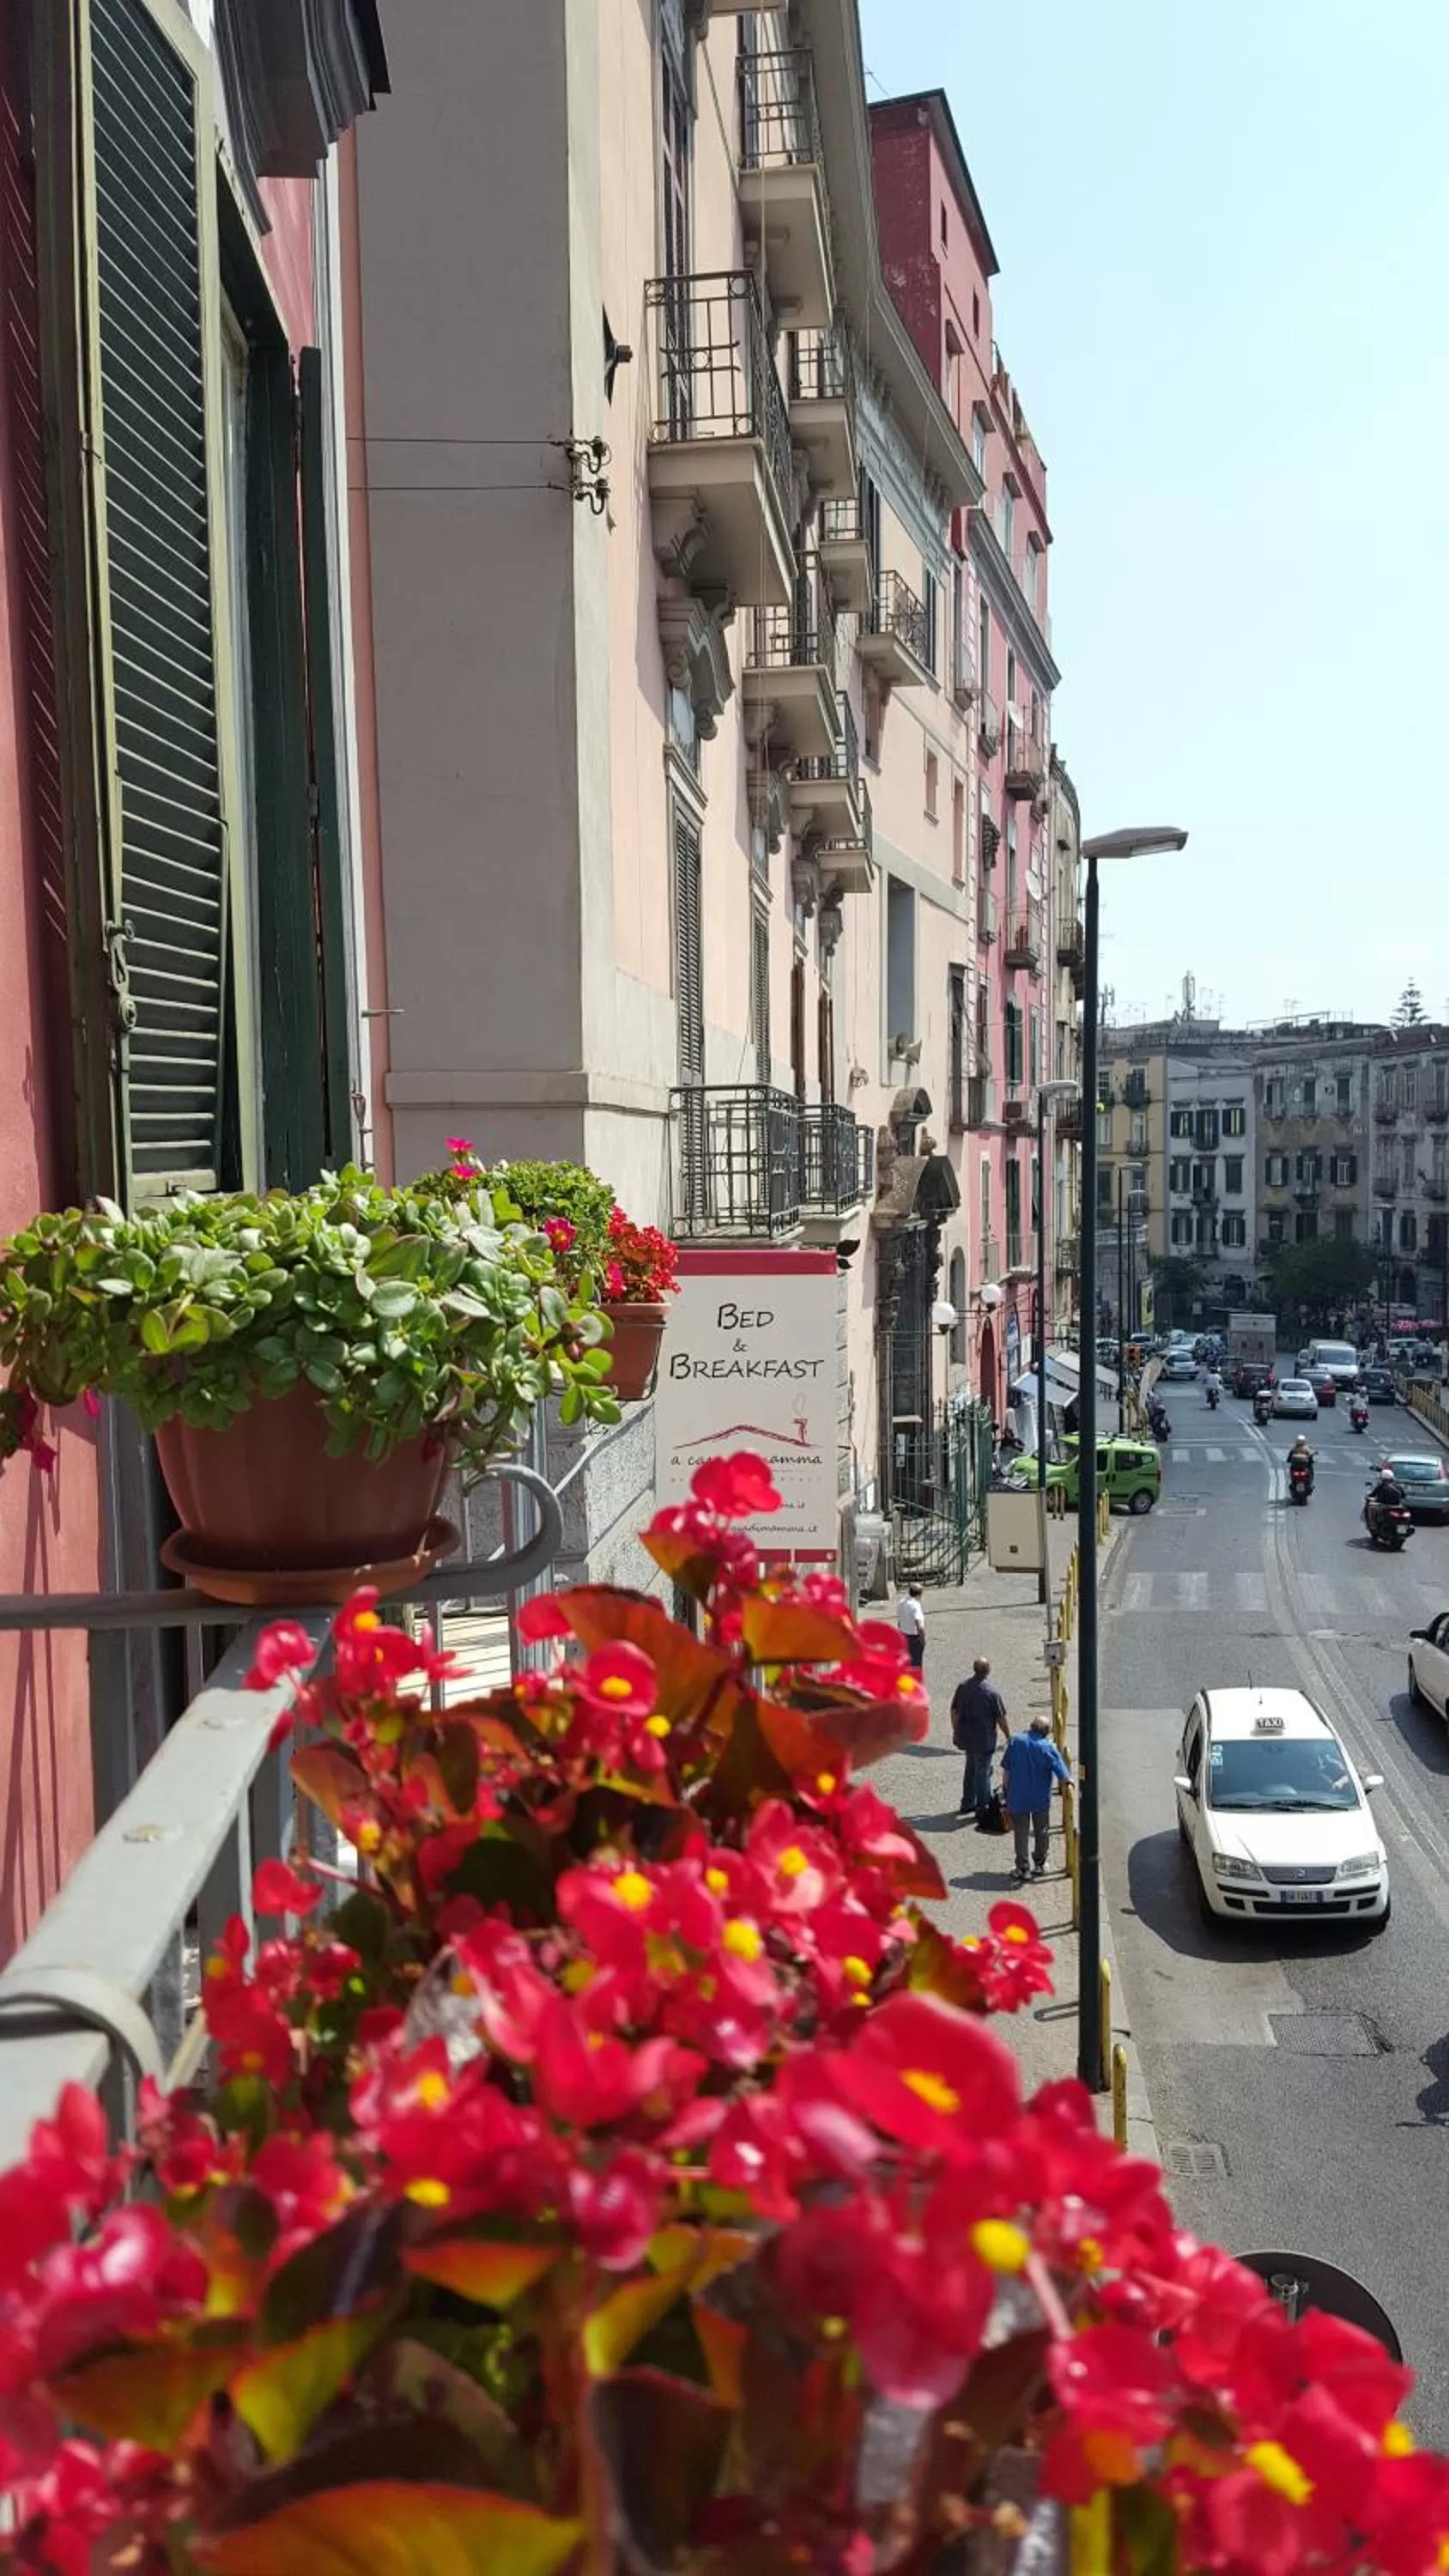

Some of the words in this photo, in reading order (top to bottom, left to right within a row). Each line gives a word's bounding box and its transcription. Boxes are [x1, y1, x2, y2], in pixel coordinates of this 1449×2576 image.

[717, 1303, 774, 1330] BED
[732, 1339, 748, 1353] &
[670, 1353, 824, 1380] BREAKFAST
[670, 1456, 681, 1466] a
[766, 1455, 822, 1465] amma
